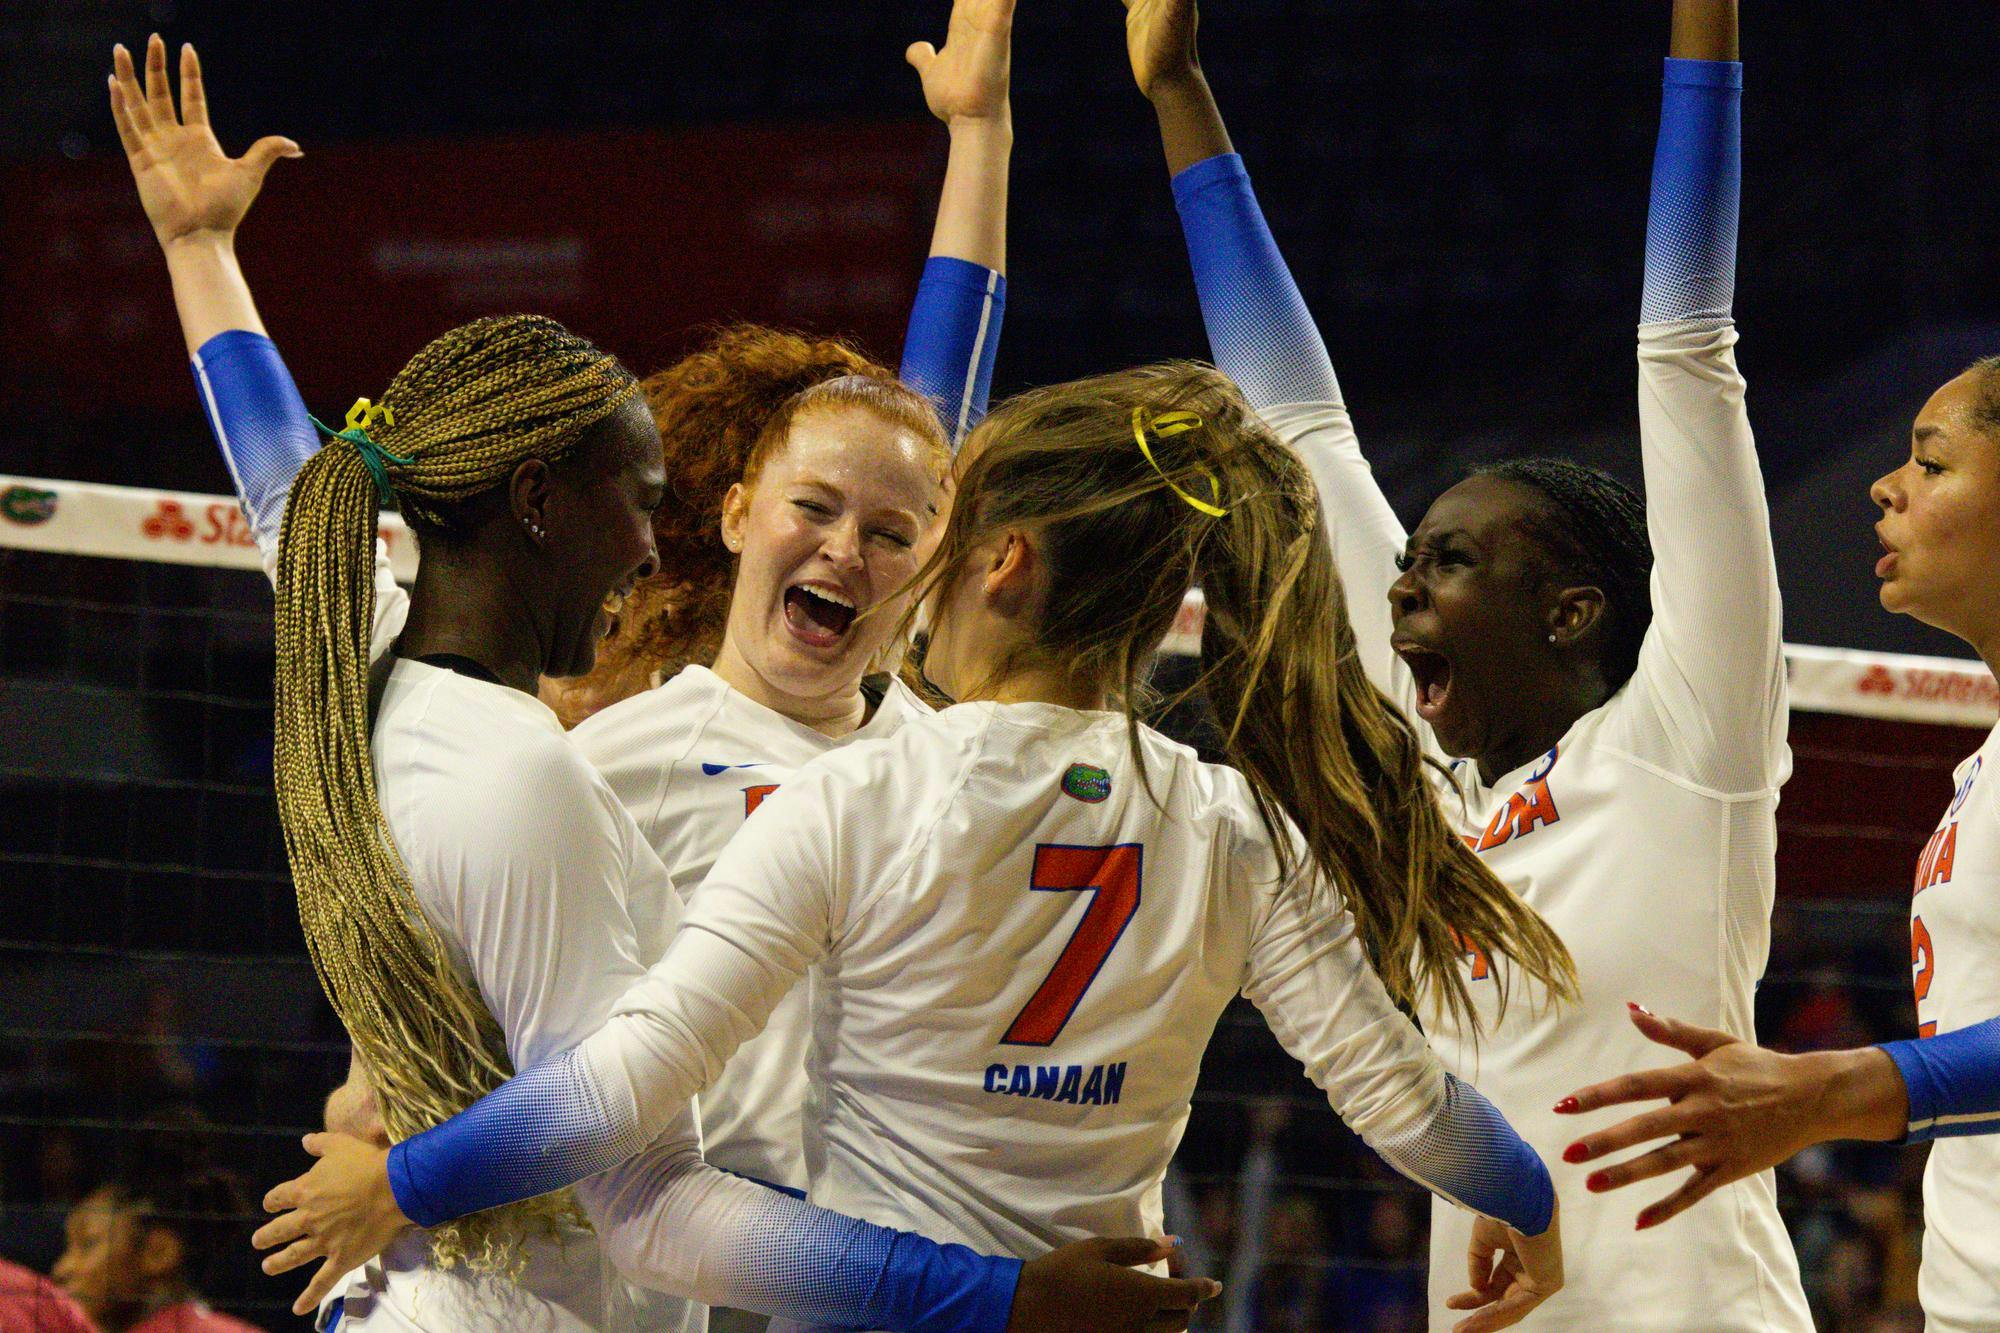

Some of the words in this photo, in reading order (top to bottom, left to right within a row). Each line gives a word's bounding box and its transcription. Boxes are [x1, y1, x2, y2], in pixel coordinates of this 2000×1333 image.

[1459, 776, 1560, 852] DA
[999, 842, 1143, 1046] 7
[983, 1062, 1127, 1106] CANAAN
